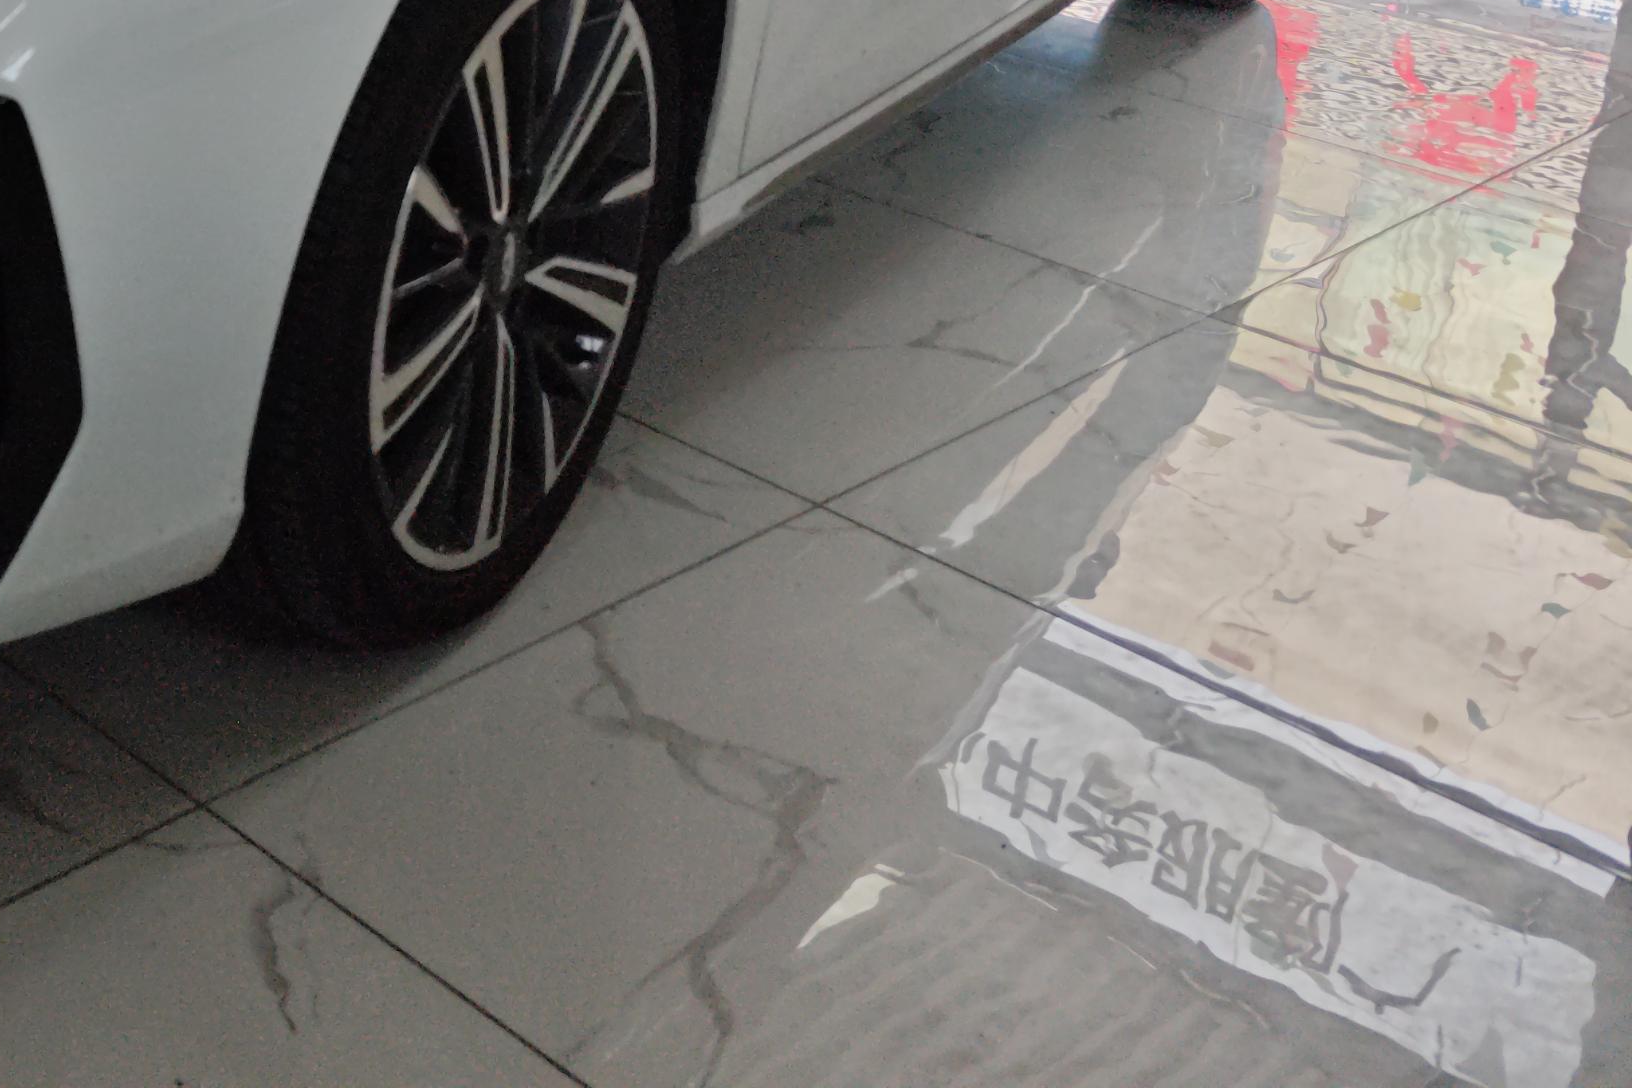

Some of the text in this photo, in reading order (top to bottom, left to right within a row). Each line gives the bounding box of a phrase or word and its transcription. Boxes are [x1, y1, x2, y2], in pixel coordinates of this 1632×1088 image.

[960, 733, 1460, 1016] 广隆服务中
